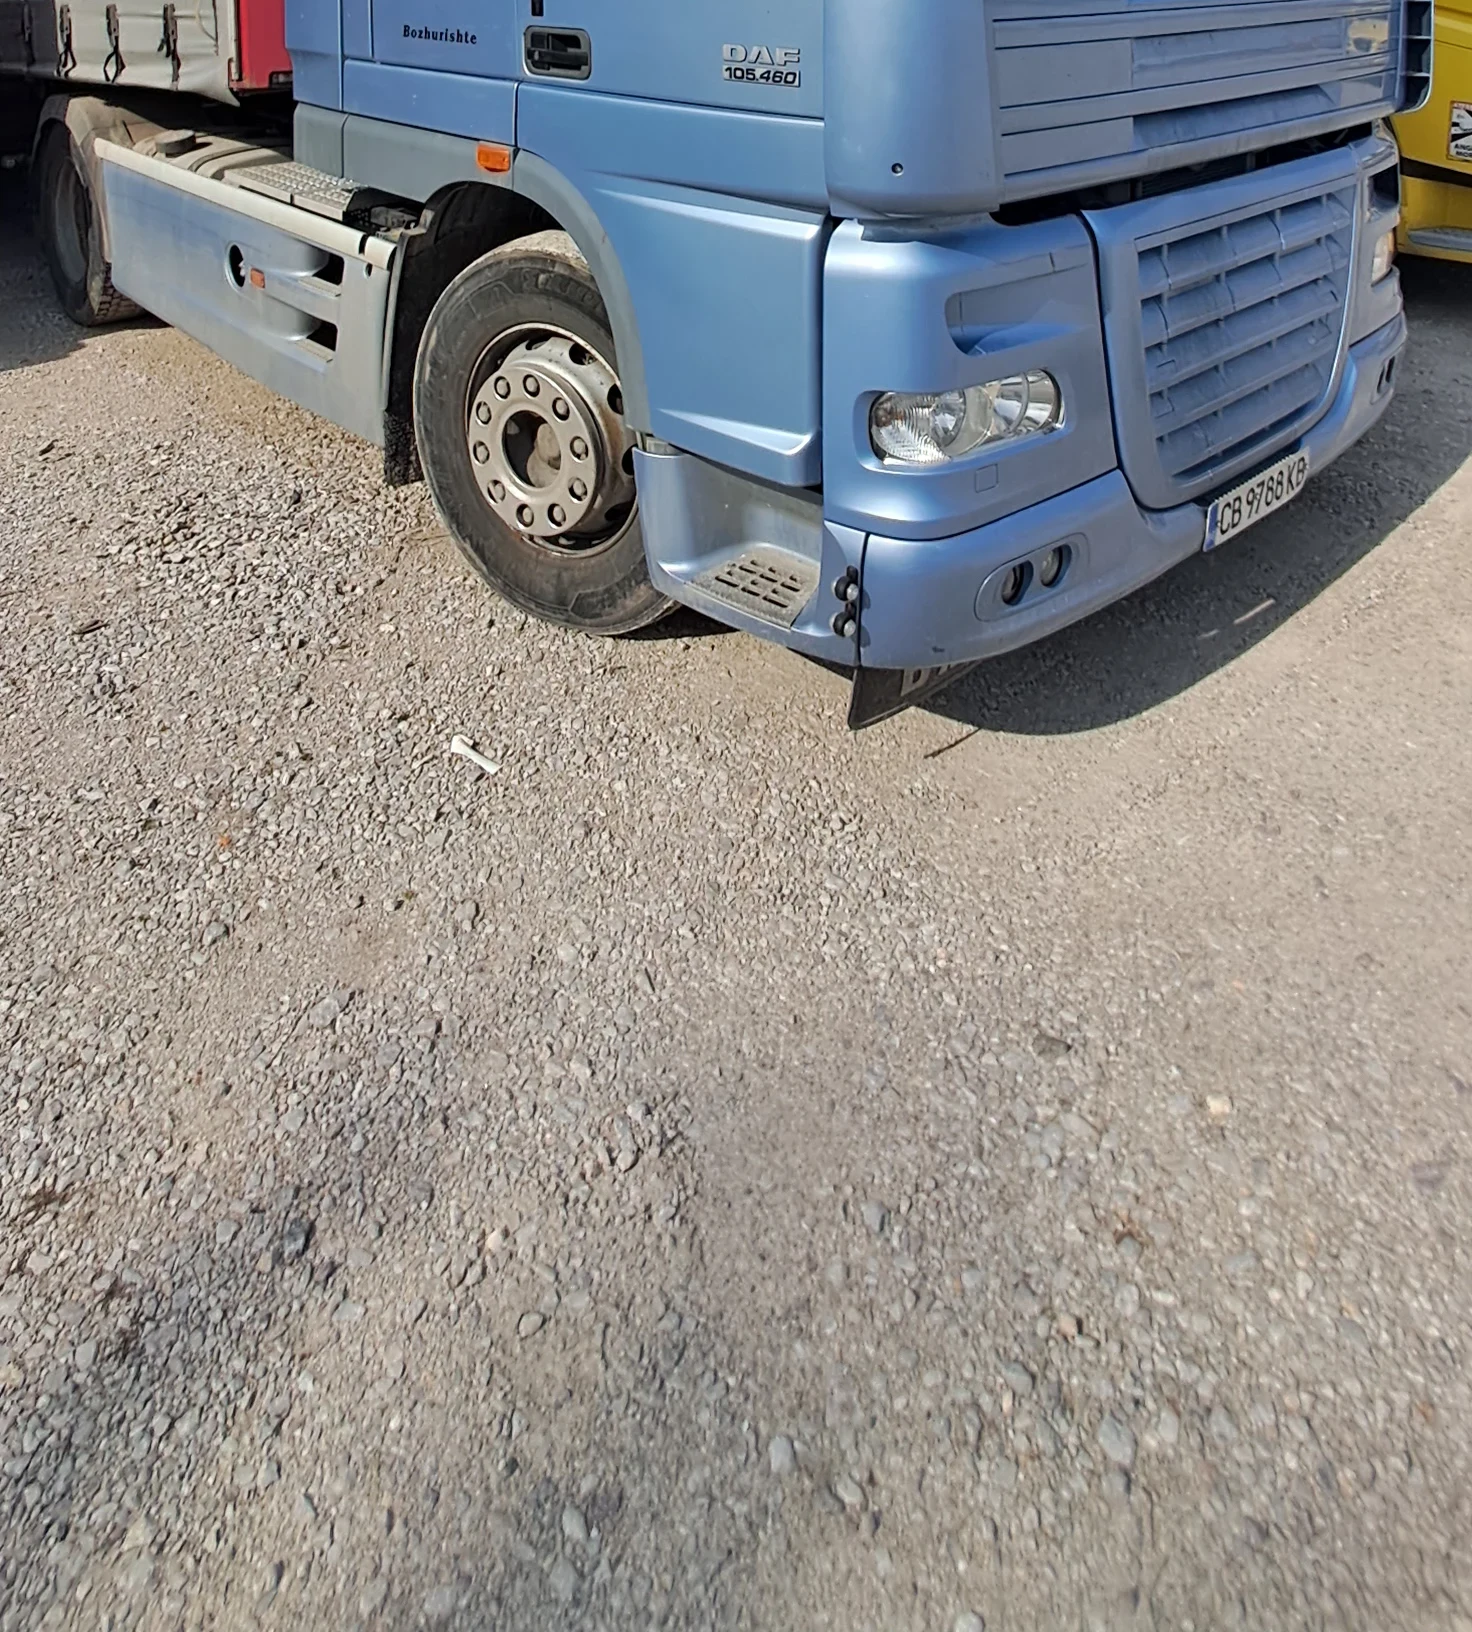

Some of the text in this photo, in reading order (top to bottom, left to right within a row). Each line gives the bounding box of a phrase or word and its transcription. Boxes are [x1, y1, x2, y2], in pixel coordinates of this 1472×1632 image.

[402, 24, 478, 45] Bozhurishte
[722, 43, 801, 67] DAF
[724, 66, 798, 85] 105.460
[1220, 456, 1306, 536] CB 9788 KB
